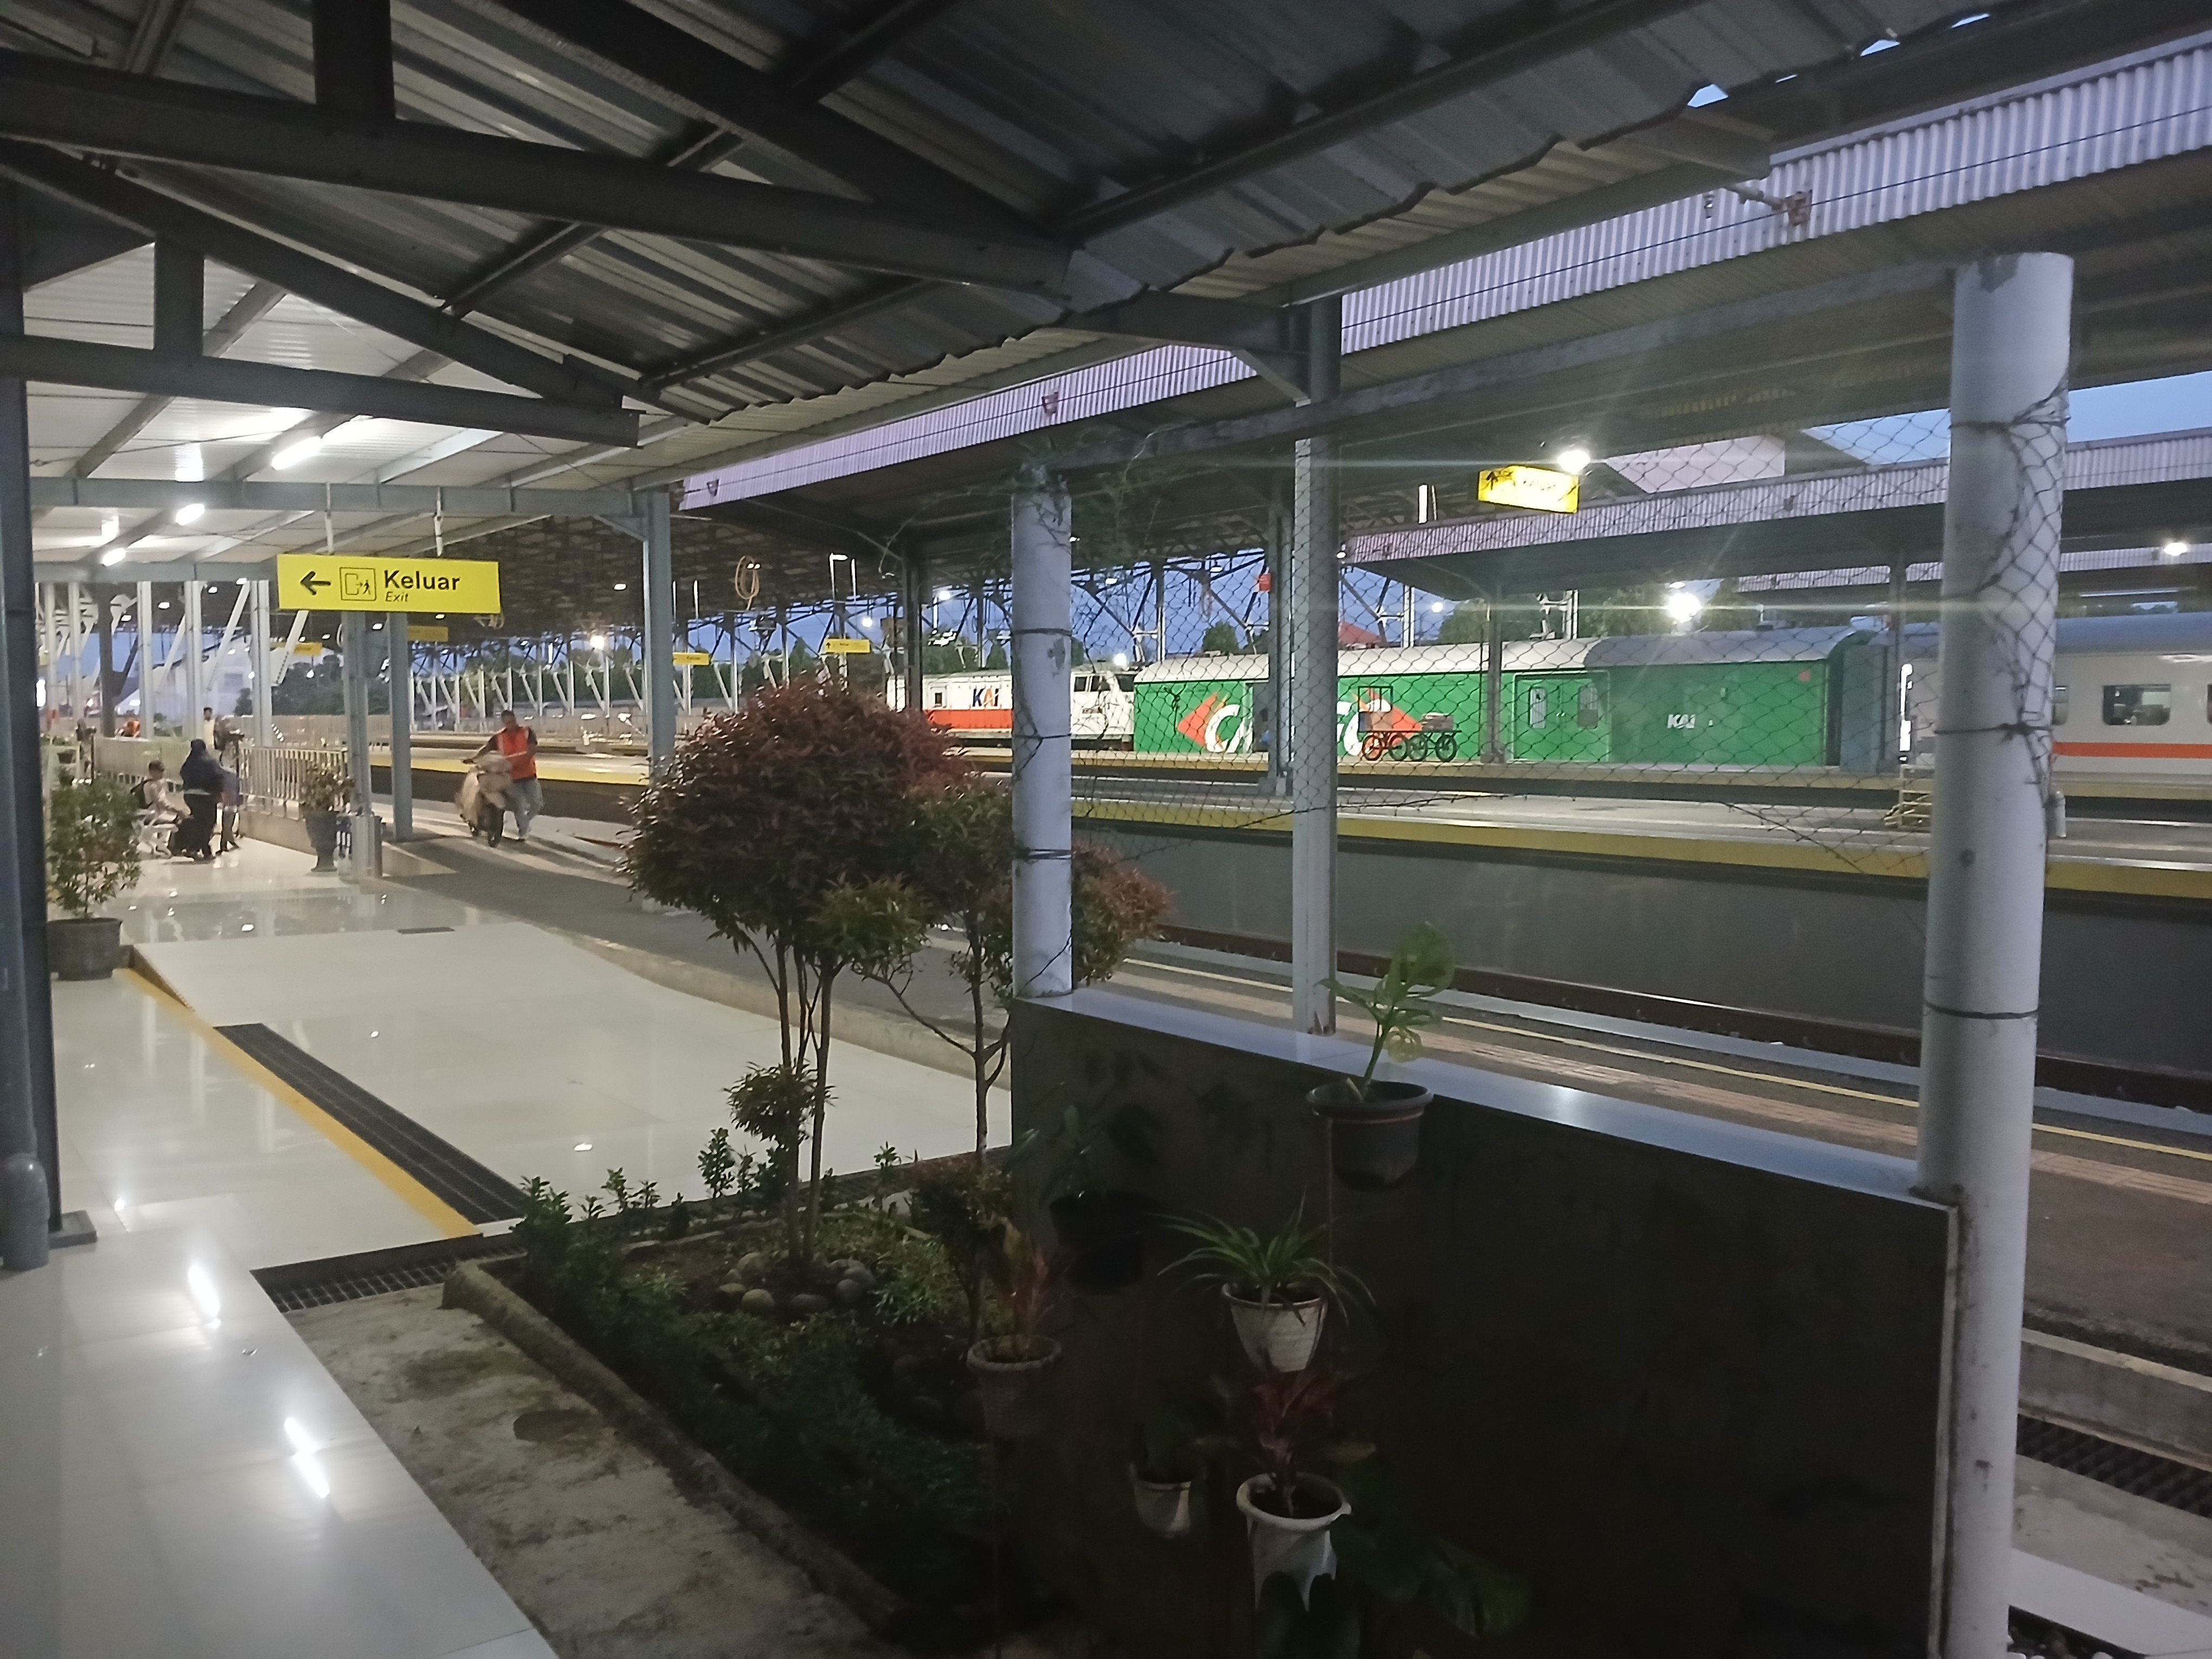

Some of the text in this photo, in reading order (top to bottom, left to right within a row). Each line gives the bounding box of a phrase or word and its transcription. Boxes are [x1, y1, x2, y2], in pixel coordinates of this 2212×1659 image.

[384, 570, 460, 590] Keluar
[385, 591, 408, 602] Exit
[972, 688, 999, 707] KAI
[1667, 714, 1695, 729] KAI
